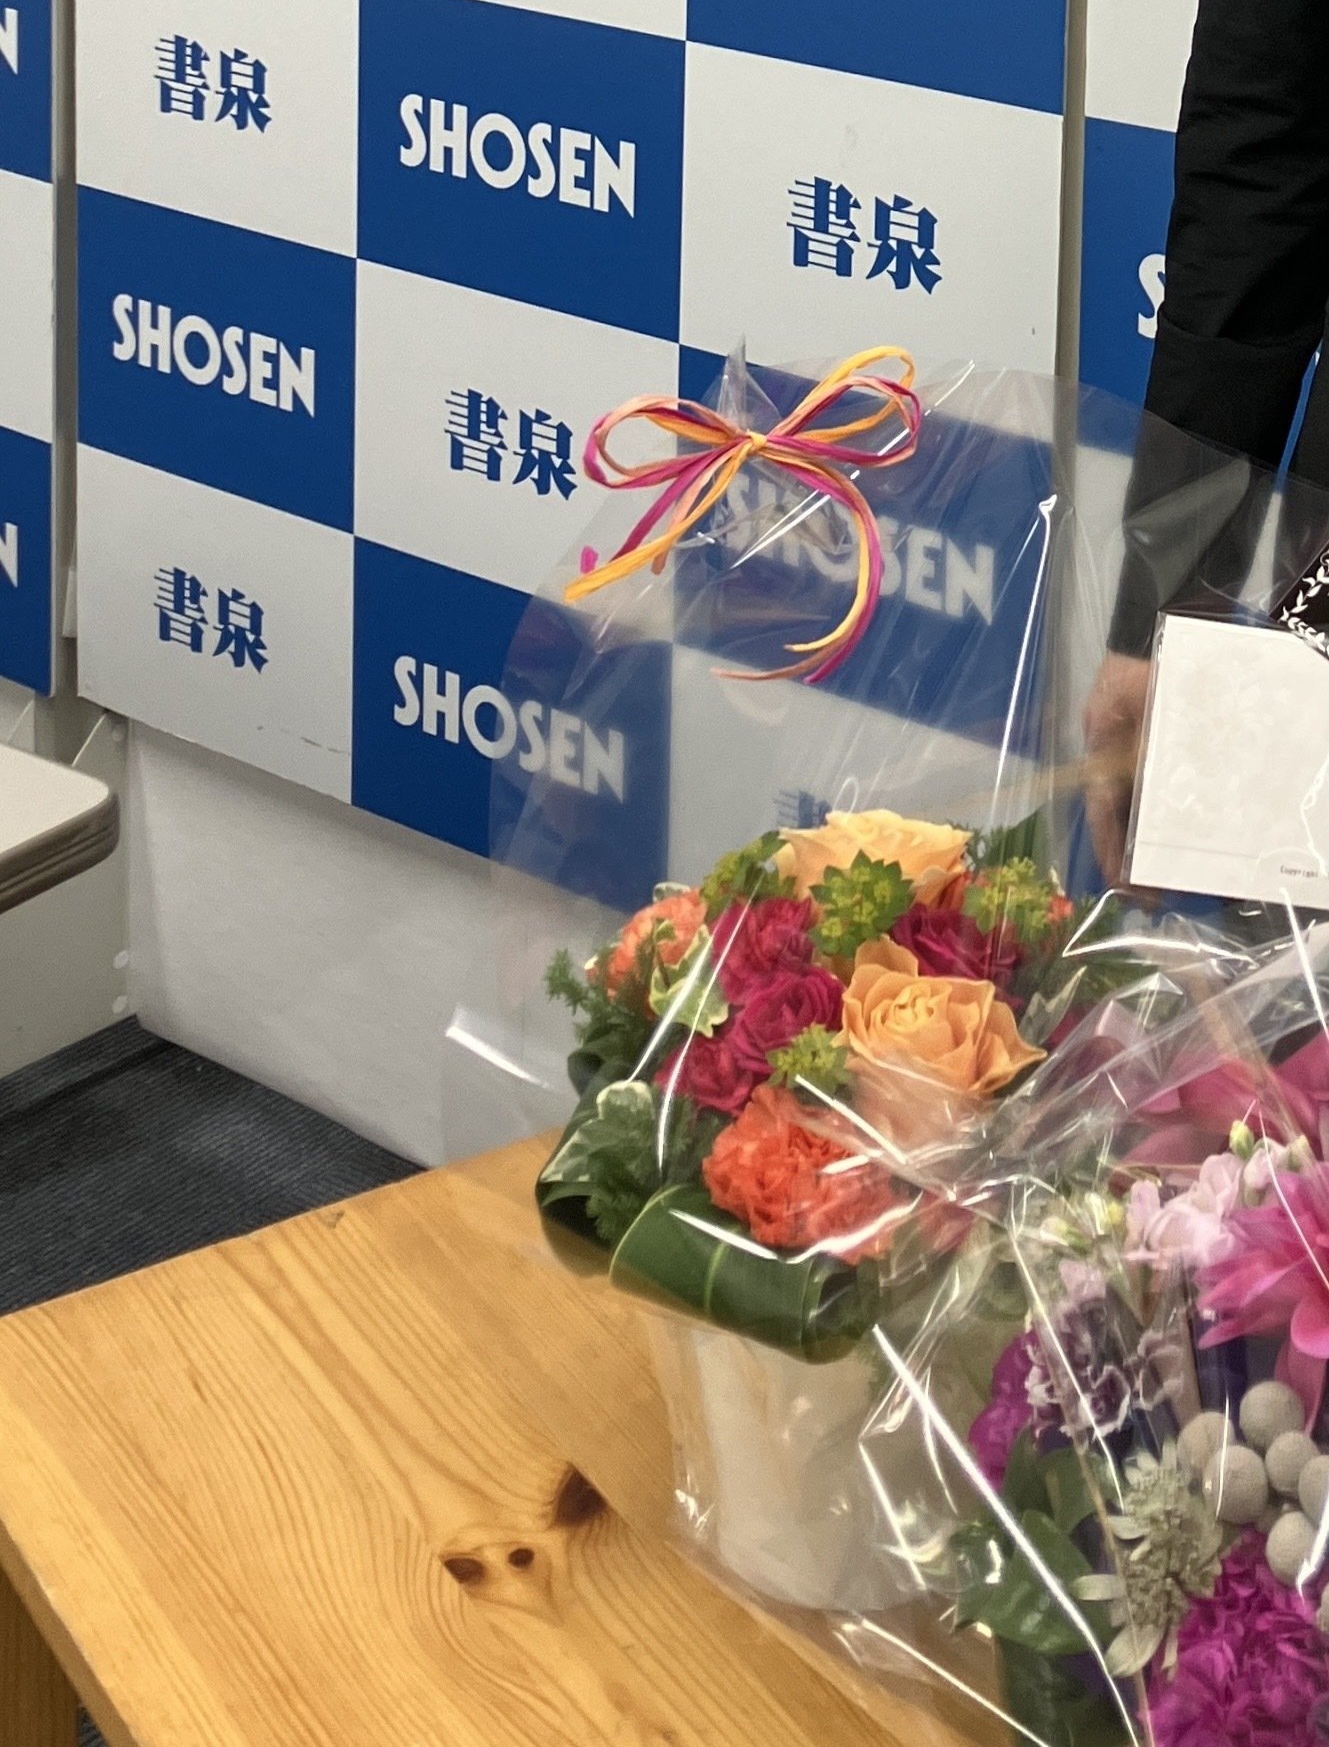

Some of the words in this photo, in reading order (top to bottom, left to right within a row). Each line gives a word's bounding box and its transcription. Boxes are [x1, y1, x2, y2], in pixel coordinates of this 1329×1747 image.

[154, 36, 271, 132] 書泉
[400, 94, 635, 217] SHOSEN
[786, 177, 944, 294] 書泉
[113, 294, 315, 416] SHOSEN
[444, 389, 577, 499] 書泉
[154, 569, 267, 670] 書泉
[393, 656, 624, 802] SHOSEN
